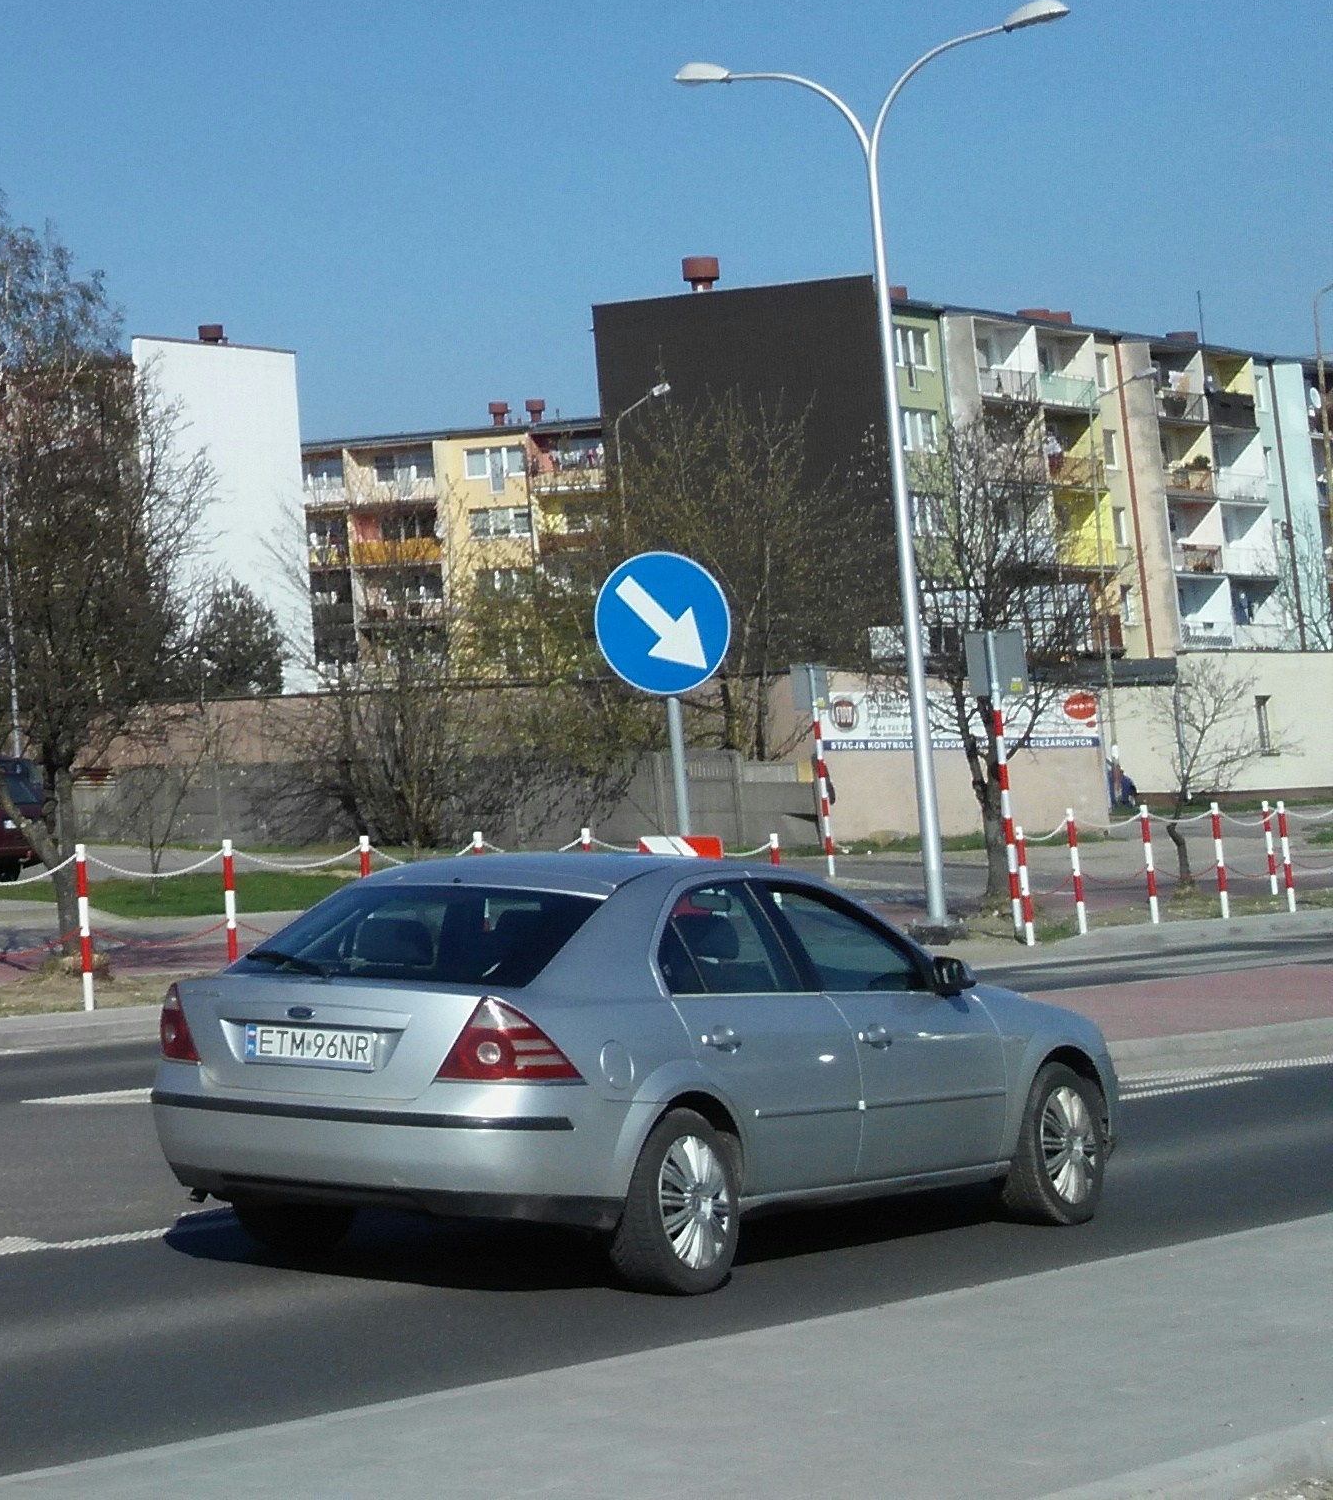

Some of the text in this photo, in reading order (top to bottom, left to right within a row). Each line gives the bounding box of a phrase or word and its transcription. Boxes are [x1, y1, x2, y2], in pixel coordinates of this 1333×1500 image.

[831, 741, 865, 750] STACJA
[259, 1029, 370, 1062] ETM 96NR
